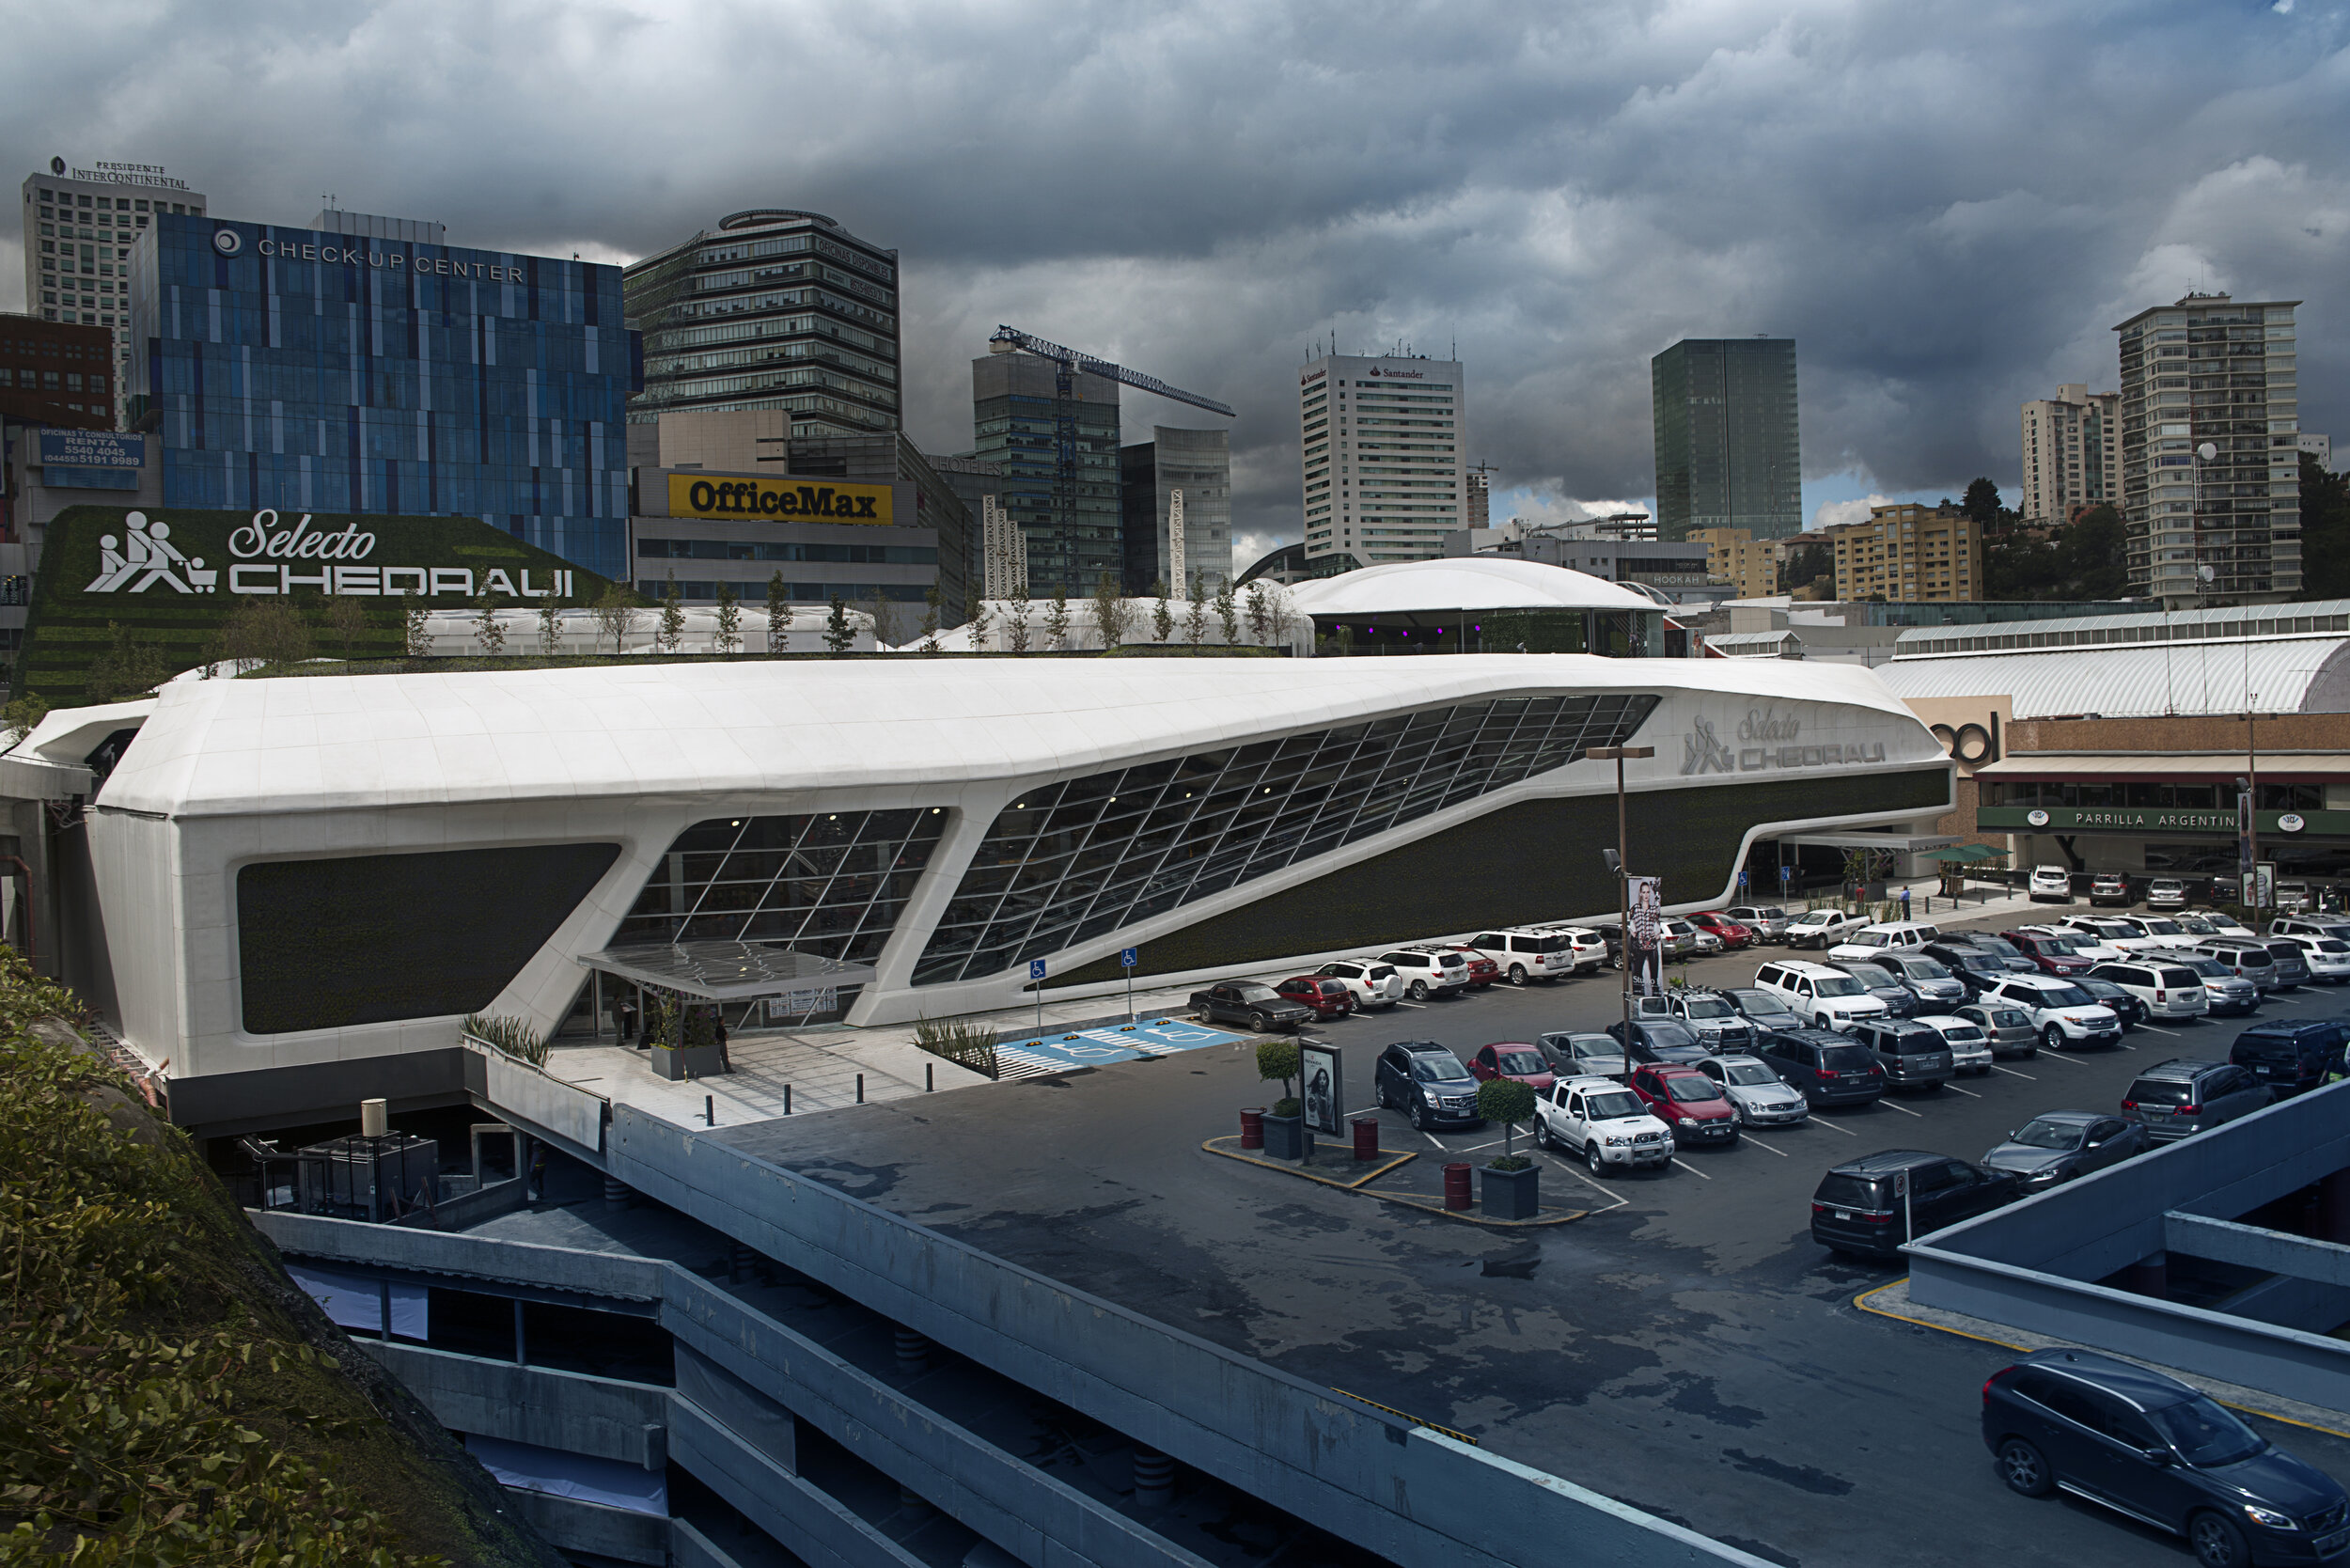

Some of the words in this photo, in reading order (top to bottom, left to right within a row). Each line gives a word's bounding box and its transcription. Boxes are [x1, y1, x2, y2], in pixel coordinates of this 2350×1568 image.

[96, 161, 165, 174] PRESIDENTE
[819, 240, 851, 262] OFICINAS
[258, 239, 404, 269] CHECK-UP
[415, 257, 524, 283] CENTER
[1383, 368, 1424, 379] Santander
[40, 429, 77, 437] OFICINAS
[85, 431, 143, 441] CONSULTORIOS
[65, 437, 118, 447] RENTA
[64, 446, 94, 454] 5540
[97, 447, 126, 456] 4045
[79, 455, 107, 463] 5191
[111, 456, 140, 465] 9989
[939, 456, 1001, 476] HOTELES
[689, 480, 877, 518] OfficeMax
[228, 509, 376, 560] Selecto
[228, 564, 573, 598] CHEDRAUI
[1653, 575, 1700, 584] HOOKAH
[1737, 707, 1800, 744] Selecto
[1740, 742, 1887, 772] CHEDRAUI
[2076, 813, 2144, 825] PARRILLA
[2158, 815, 2240, 827] ARGENTIN
